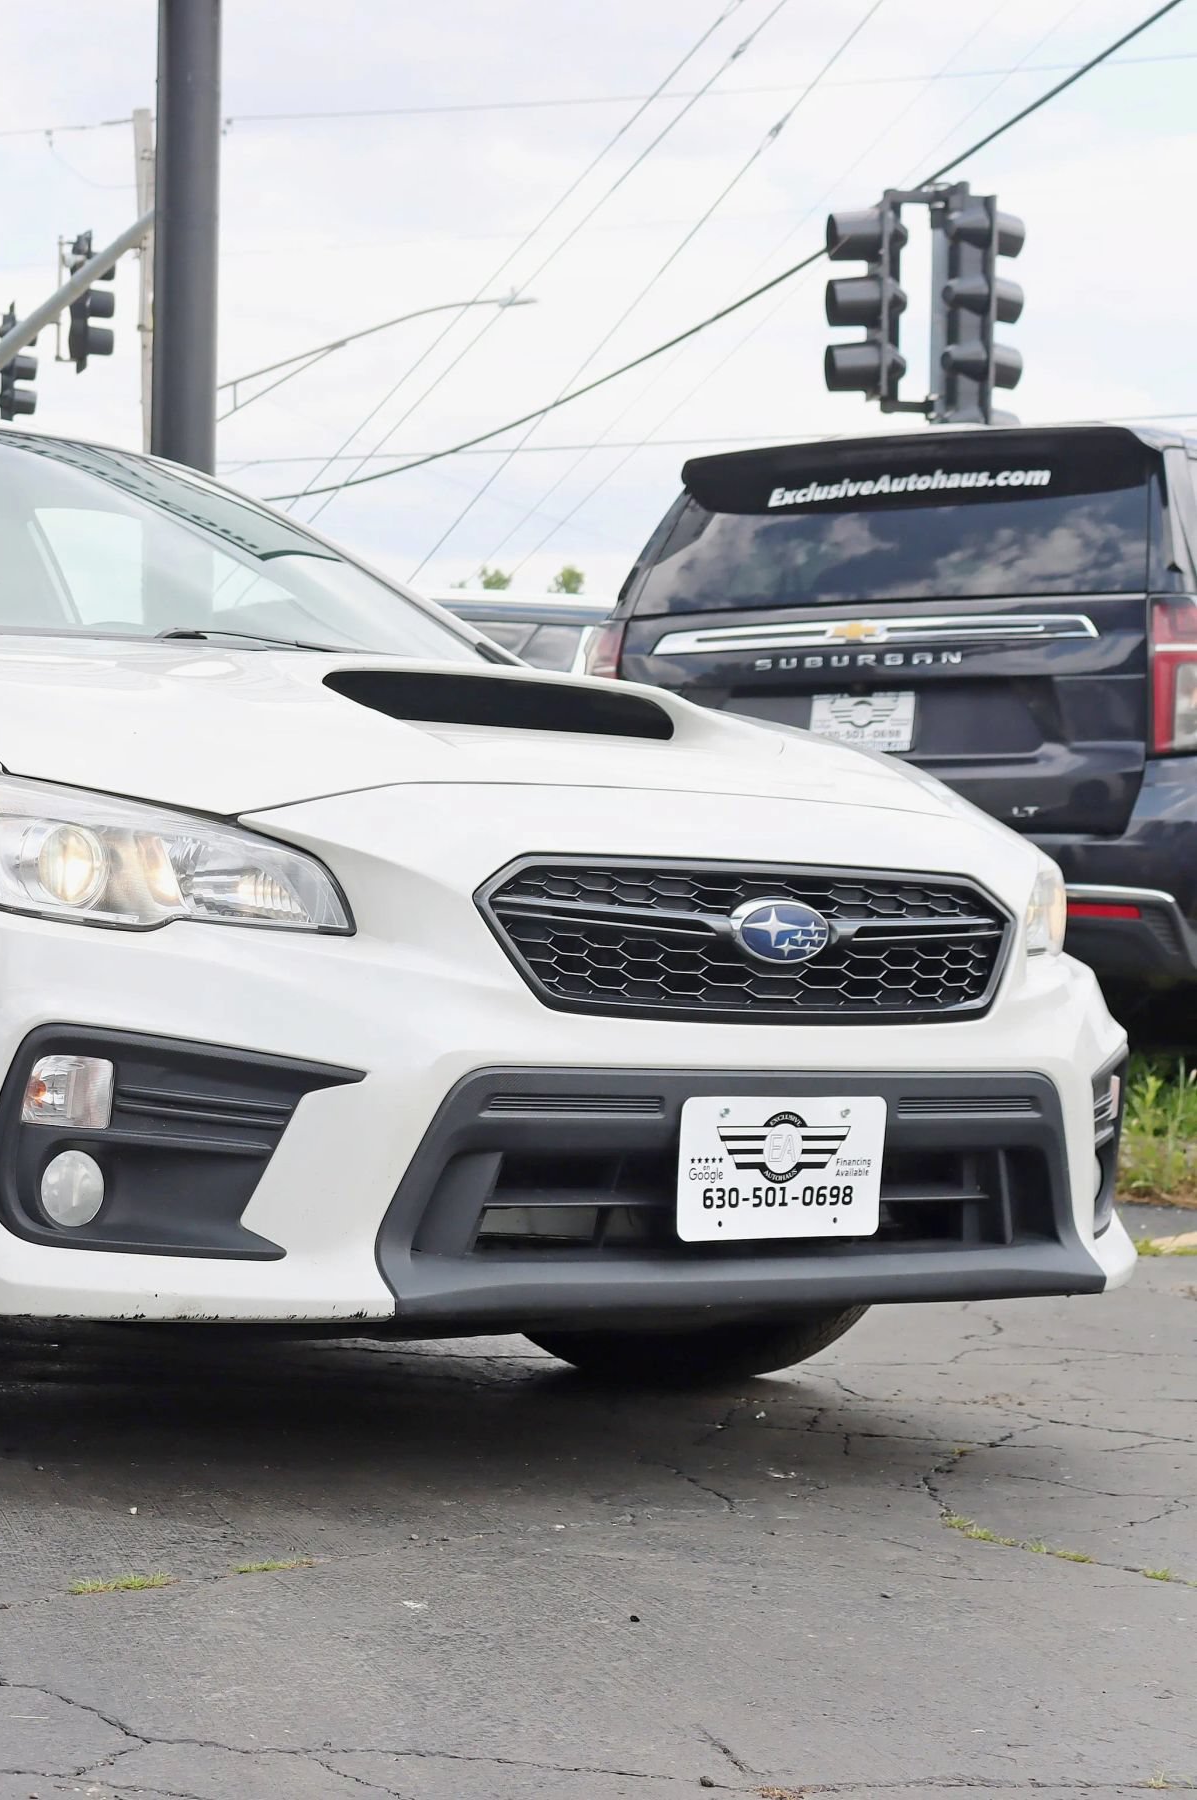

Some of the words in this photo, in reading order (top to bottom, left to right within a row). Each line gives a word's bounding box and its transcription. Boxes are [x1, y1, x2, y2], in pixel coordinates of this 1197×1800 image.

[767, 469, 1051, 507] ExclusiveAutohaus.com
[754, 651, 963, 671] SUBURBAN
[1012, 805, 1040, 818] LT
[769, 1113, 803, 1127] EXCLUSIVE
[835, 1158, 872, 1168] Financing
[689, 1167, 723, 1184] Google
[763, 1168, 798, 1182] AUTOHAUS
[835, 1168, 870, 1177] Available
[703, 1185, 854, 1210] 630-501-0698
